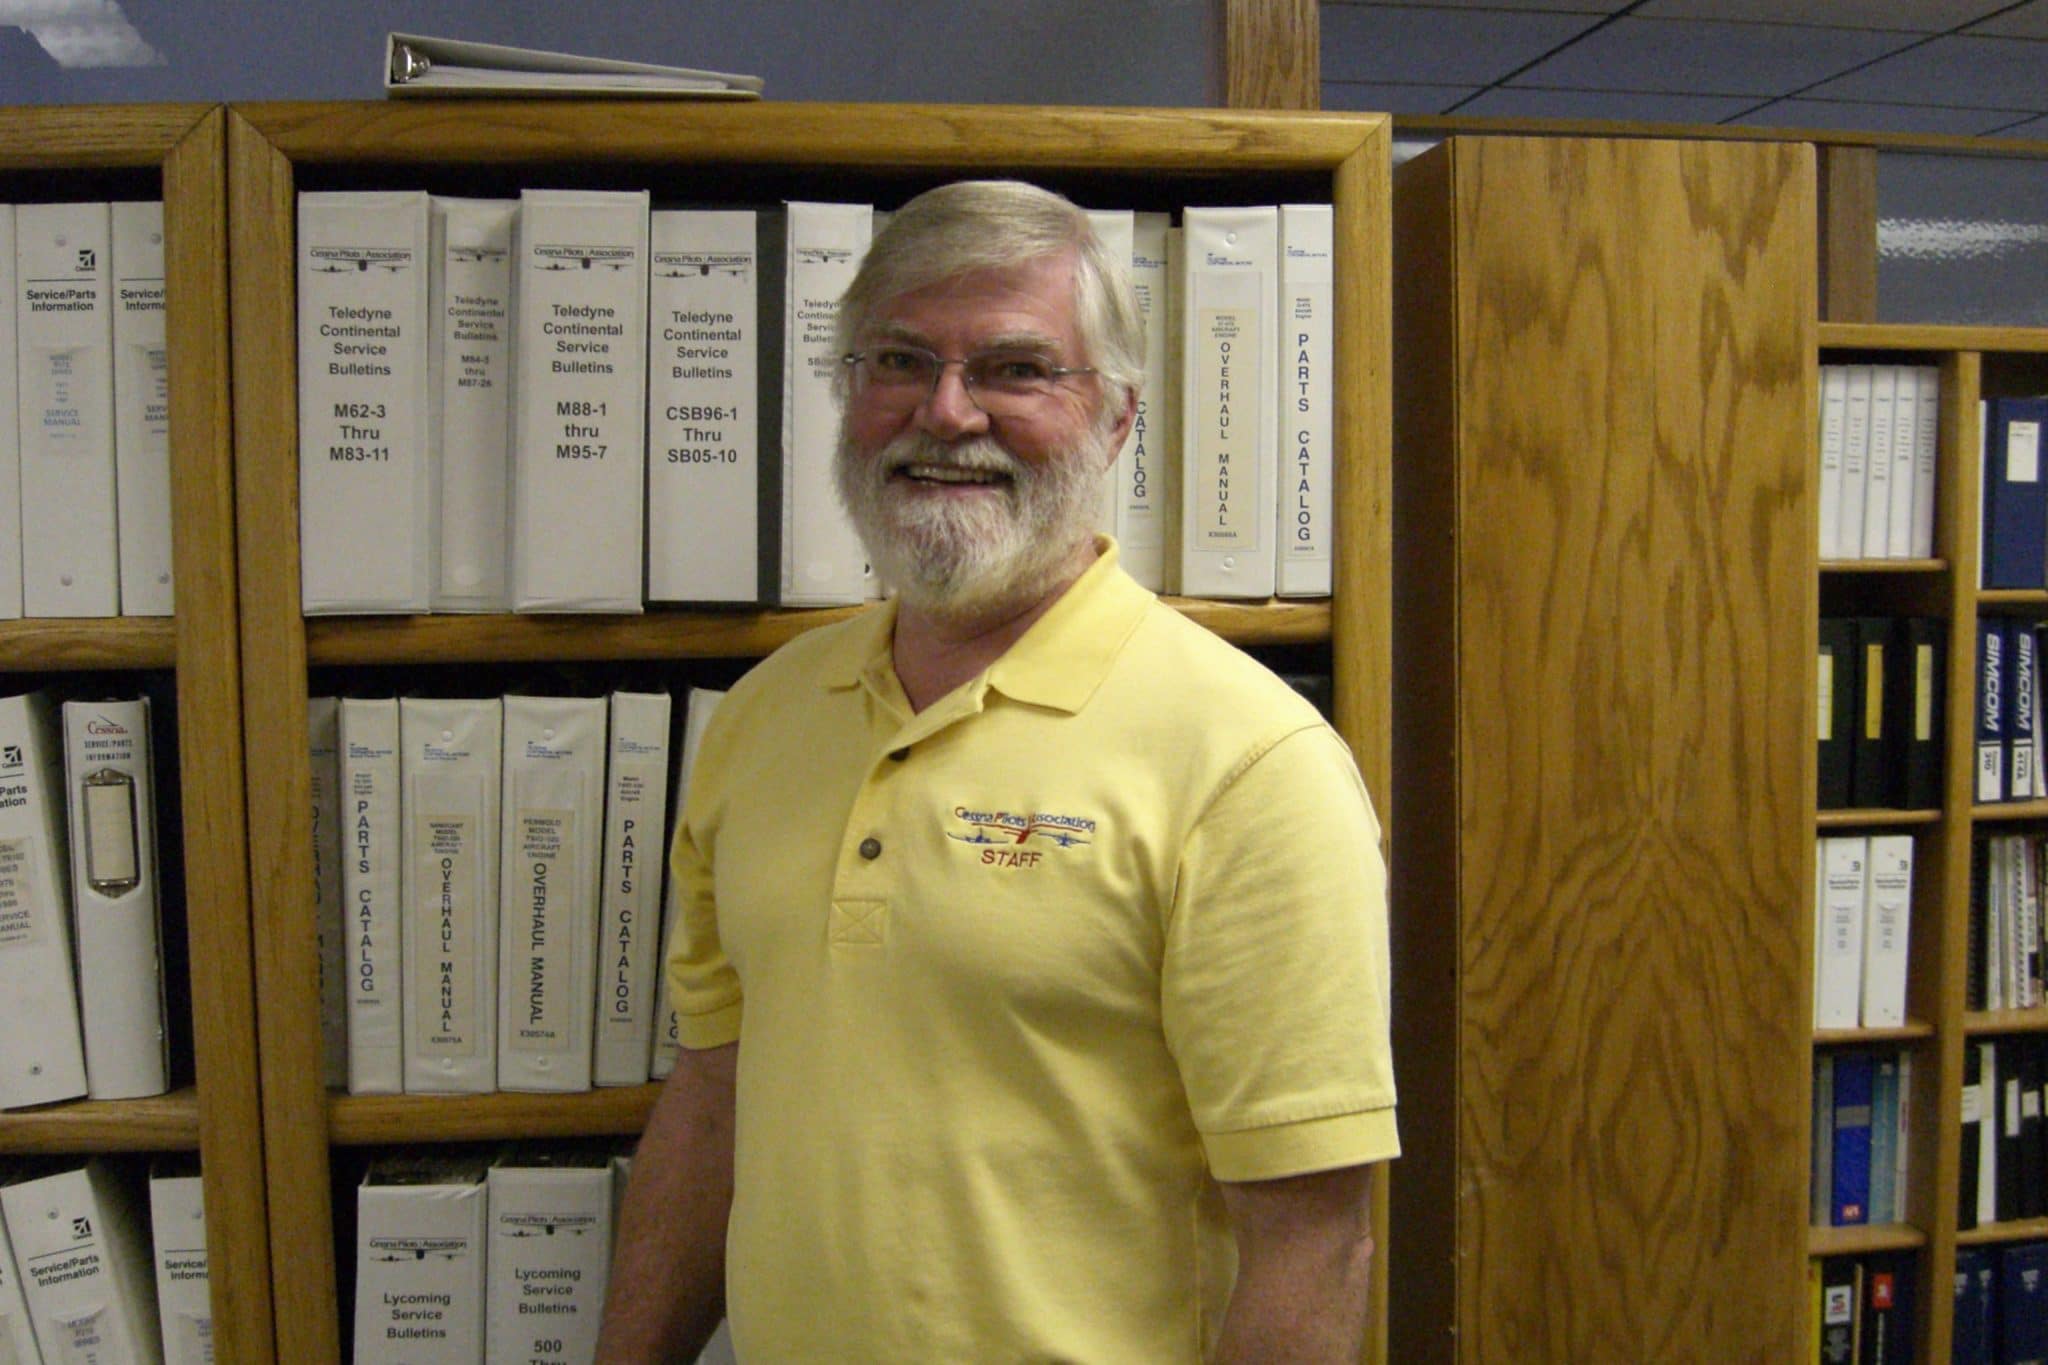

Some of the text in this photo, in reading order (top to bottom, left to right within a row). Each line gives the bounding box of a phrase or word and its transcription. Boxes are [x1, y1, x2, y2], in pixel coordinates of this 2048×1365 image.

[27, 289, 96, 301] Service/Parts
[455, 296, 499, 307] Teledyne
[31, 301, 94, 312] Information
[552, 304, 615, 319] Teledyne
[804, 299, 840, 310] Teledyn
[328, 306, 392, 322] Teledyne
[448, 308, 504, 318] Continental
[671, 311, 733, 326] Teledyne
[320, 324, 400, 338] Continental
[458, 320, 494, 329] Service
[543, 322, 623, 336] Continental
[454, 331, 498, 341] Bulletins
[664, 329, 742, 341] Continental
[333, 342, 387, 356] Service
[556, 341, 609, 354] Service
[677, 347, 728, 359] Service
[329, 363, 391, 376] Bulletins
[465, 367, 486, 376] thru
[552, 361, 613, 374] Bulletins
[672, 366, 733, 379] Bulletins
[1298, 333, 1310, 412] PARTS
[333, 404, 386, 418] M62-3
[557, 402, 607, 416] M88-1
[666, 407, 737, 421] CSB96-1
[43, 418, 80, 427] MANUAL
[340, 425, 380, 440] Thru
[565, 424, 599, 438] thru
[683, 428, 721, 442] Thru
[1219, 342, 1231, 526] OVERHAUL MANUAL
[329, 447, 389, 461] M83-11
[556, 445, 607, 459] M95-7
[667, 449, 737, 463] SB05-10
[1134, 401, 1147, 498] CATALOG
[1297, 431, 1311, 541] CATALOG
[1984, 632, 2001, 732] SIMCOM
[2017, 632, 2032, 731] SIMCOM
[86, 752, 131, 761] INFORMATION
[955, 807, 993, 823] Cessna
[994, 812, 1026, 828] Pilots
[358, 800, 370, 874] PARTS
[620, 820, 635, 894] PARTS
[981, 849, 1043, 867] STAFF
[359, 890, 374, 992] CATALOG
[441, 858, 453, 1032] OVERHAUL MANUAL
[530, 862, 547, 1025] OVERHAUL MANUAL
[615, 910, 633, 1014] CATALOG
[30, 1254, 99, 1278] Service/Parts
[38, 1265, 99, 1287] Information
[514, 1268, 581, 1281] Lycoming
[523, 1283, 574, 1295] Service
[384, 1292, 451, 1306] Lycoming
[392, 1309, 443, 1320] Service
[519, 1303, 577, 1314] Bulletins
[387, 1328, 446, 1338] Bulletins
[534, 1340, 562, 1352] 500
